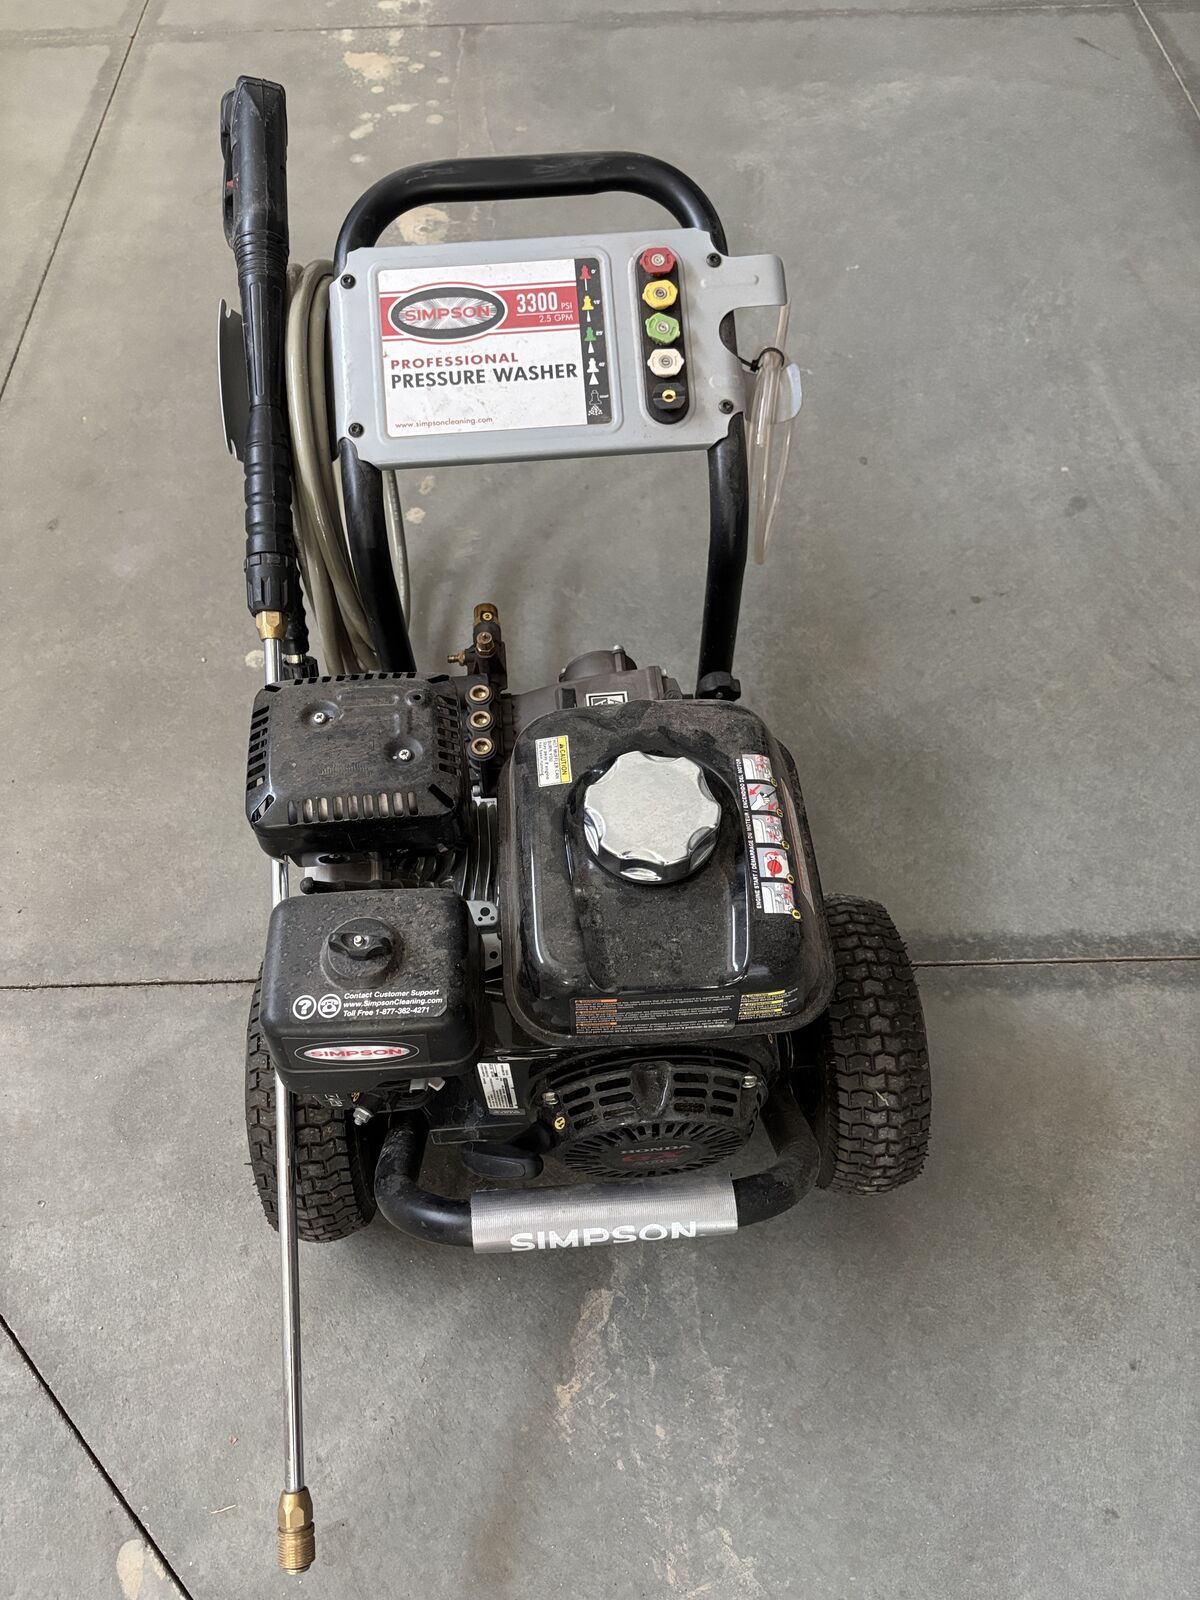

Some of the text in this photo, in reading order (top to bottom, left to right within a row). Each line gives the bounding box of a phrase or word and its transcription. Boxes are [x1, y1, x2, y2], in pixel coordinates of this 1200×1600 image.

[516, 292, 573, 313] 3300 PSI
[405, 305, 490, 321] SIMPSON
[539, 313, 574, 324] 2.5 GPM
[391, 352, 519, 370] PROFESSIONAL
[391, 363, 578, 389] PRESSURE WASHER
[395, 416, 493, 430] www.simpsoncleaning.com
[560, 749, 568, 776] CAUTION
[735, 759, 743, 774] MOTOR
[744, 812, 752, 831] MOTEUR
[752, 873, 760, 889] START
[343, 989, 439, 1000] Contact Customer Support
[343, 998, 443, 1008] www.SimpsonCleaning.com
[310, 1048, 403, 1057] SIMPSON
[620, 1144, 692, 1154] HONDA
[509, 1220, 697, 1251] SIMPSON
